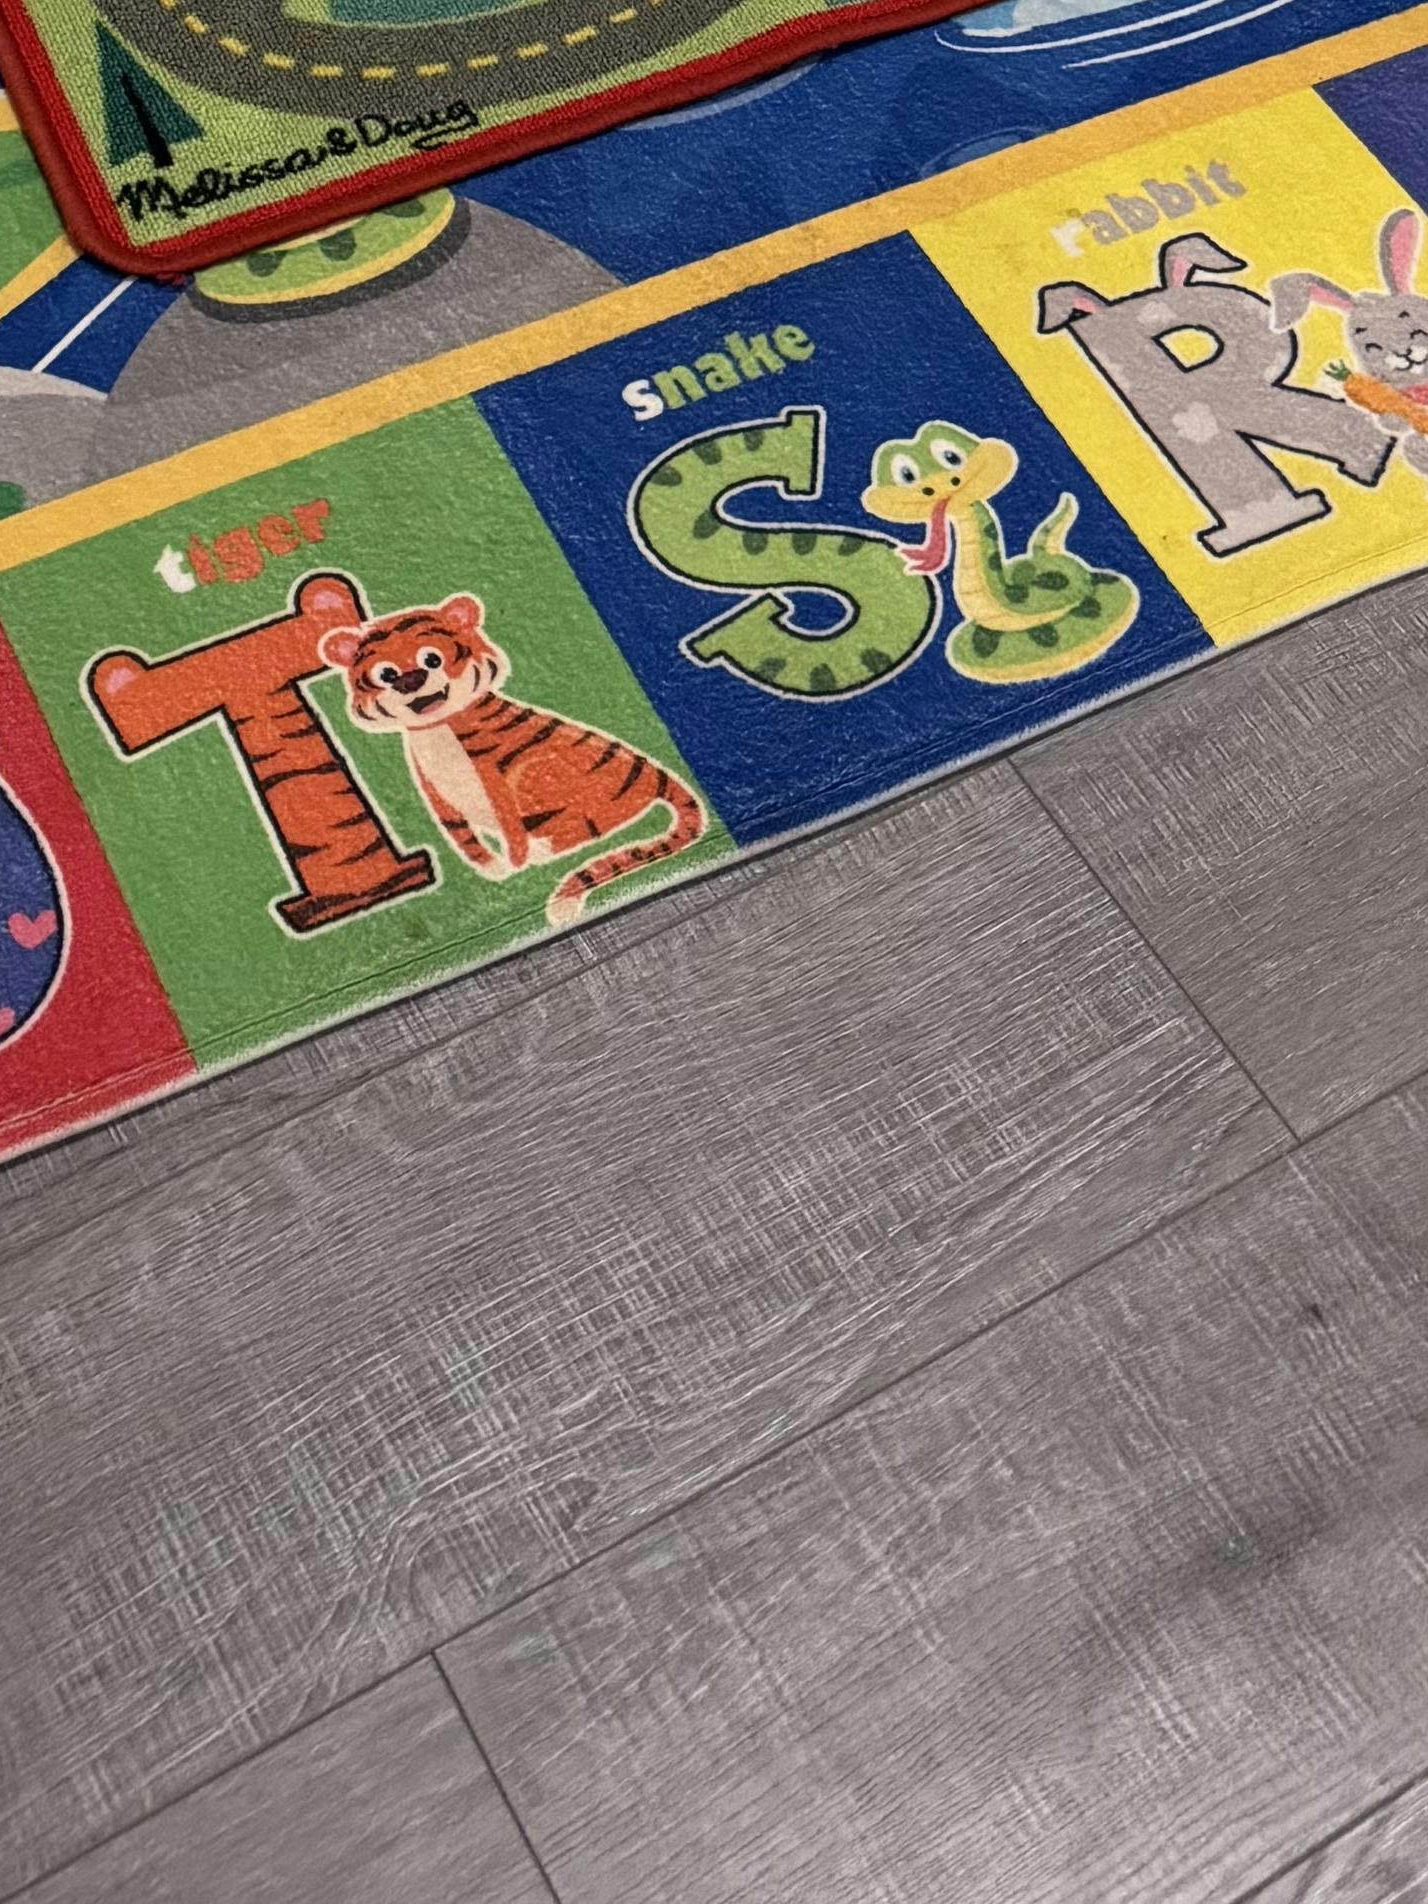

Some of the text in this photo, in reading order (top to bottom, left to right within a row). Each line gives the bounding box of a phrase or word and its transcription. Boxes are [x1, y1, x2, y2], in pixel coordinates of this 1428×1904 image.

[117, 146, 325, 222] Melissa
[353, 99, 480, 152] Doug
[1049, 156, 1247, 258] rabbit
[621, 320, 815, 423] snake
[1038, 233, 1397, 558] R
[153, 498, 330, 592] tiger
[627, 404, 942, 696] S
[80, 567, 440, 937] T
